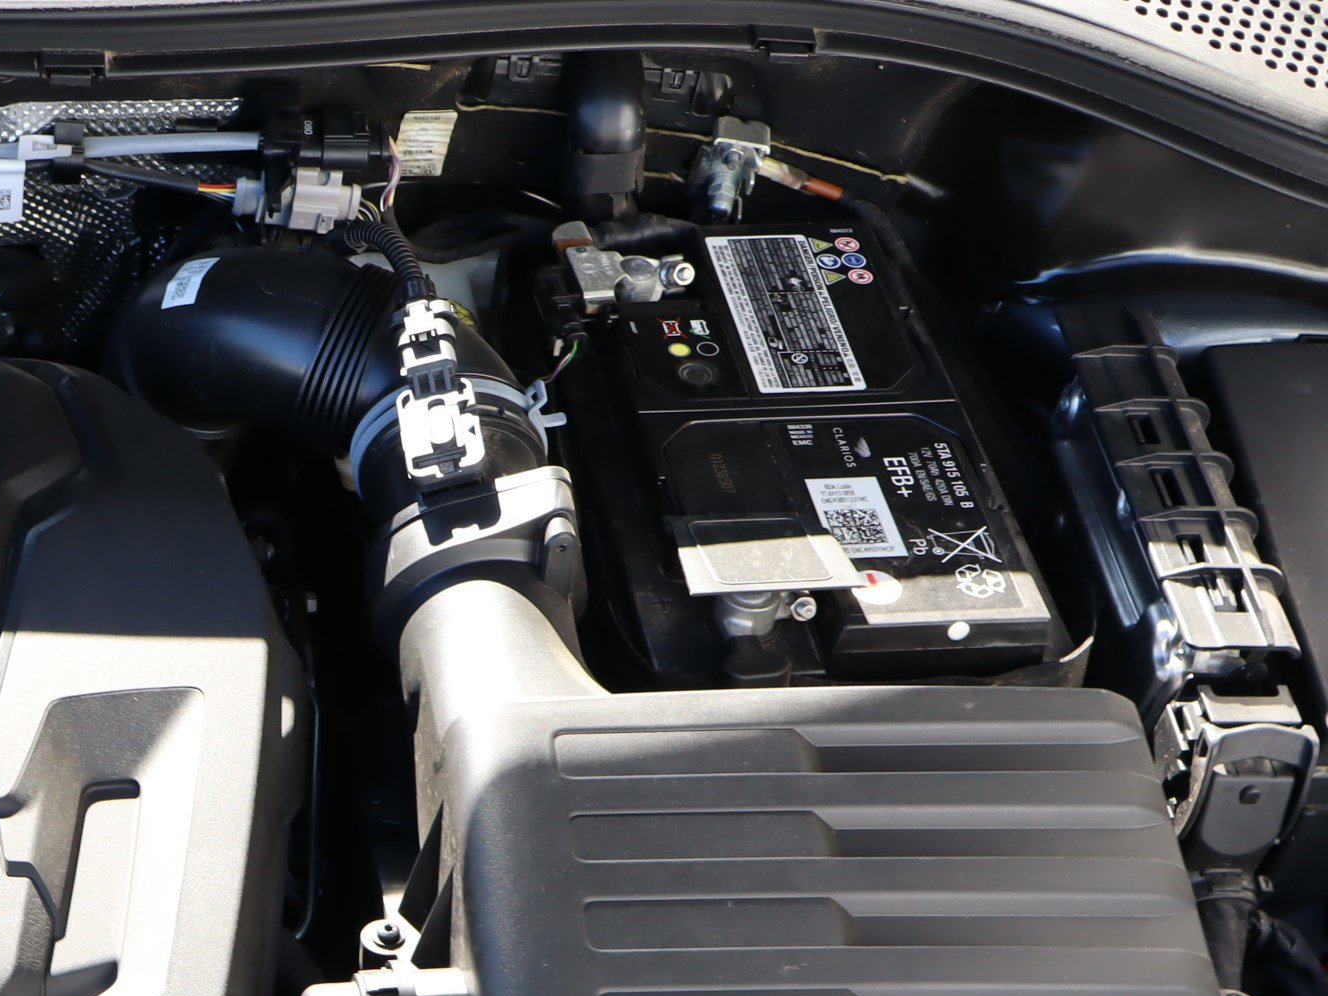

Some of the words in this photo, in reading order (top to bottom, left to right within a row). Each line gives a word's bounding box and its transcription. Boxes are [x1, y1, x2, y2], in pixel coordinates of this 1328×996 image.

[833, 427, 857, 468] CLARIOS
[934, 442, 952, 460] 5TA
[883, 456, 914, 498] EFB+
[942, 460, 961, 478] 915
[951, 480, 969, 497] 105
[960, 501, 974, 509] B
[909, 538, 929, 556] Pb
